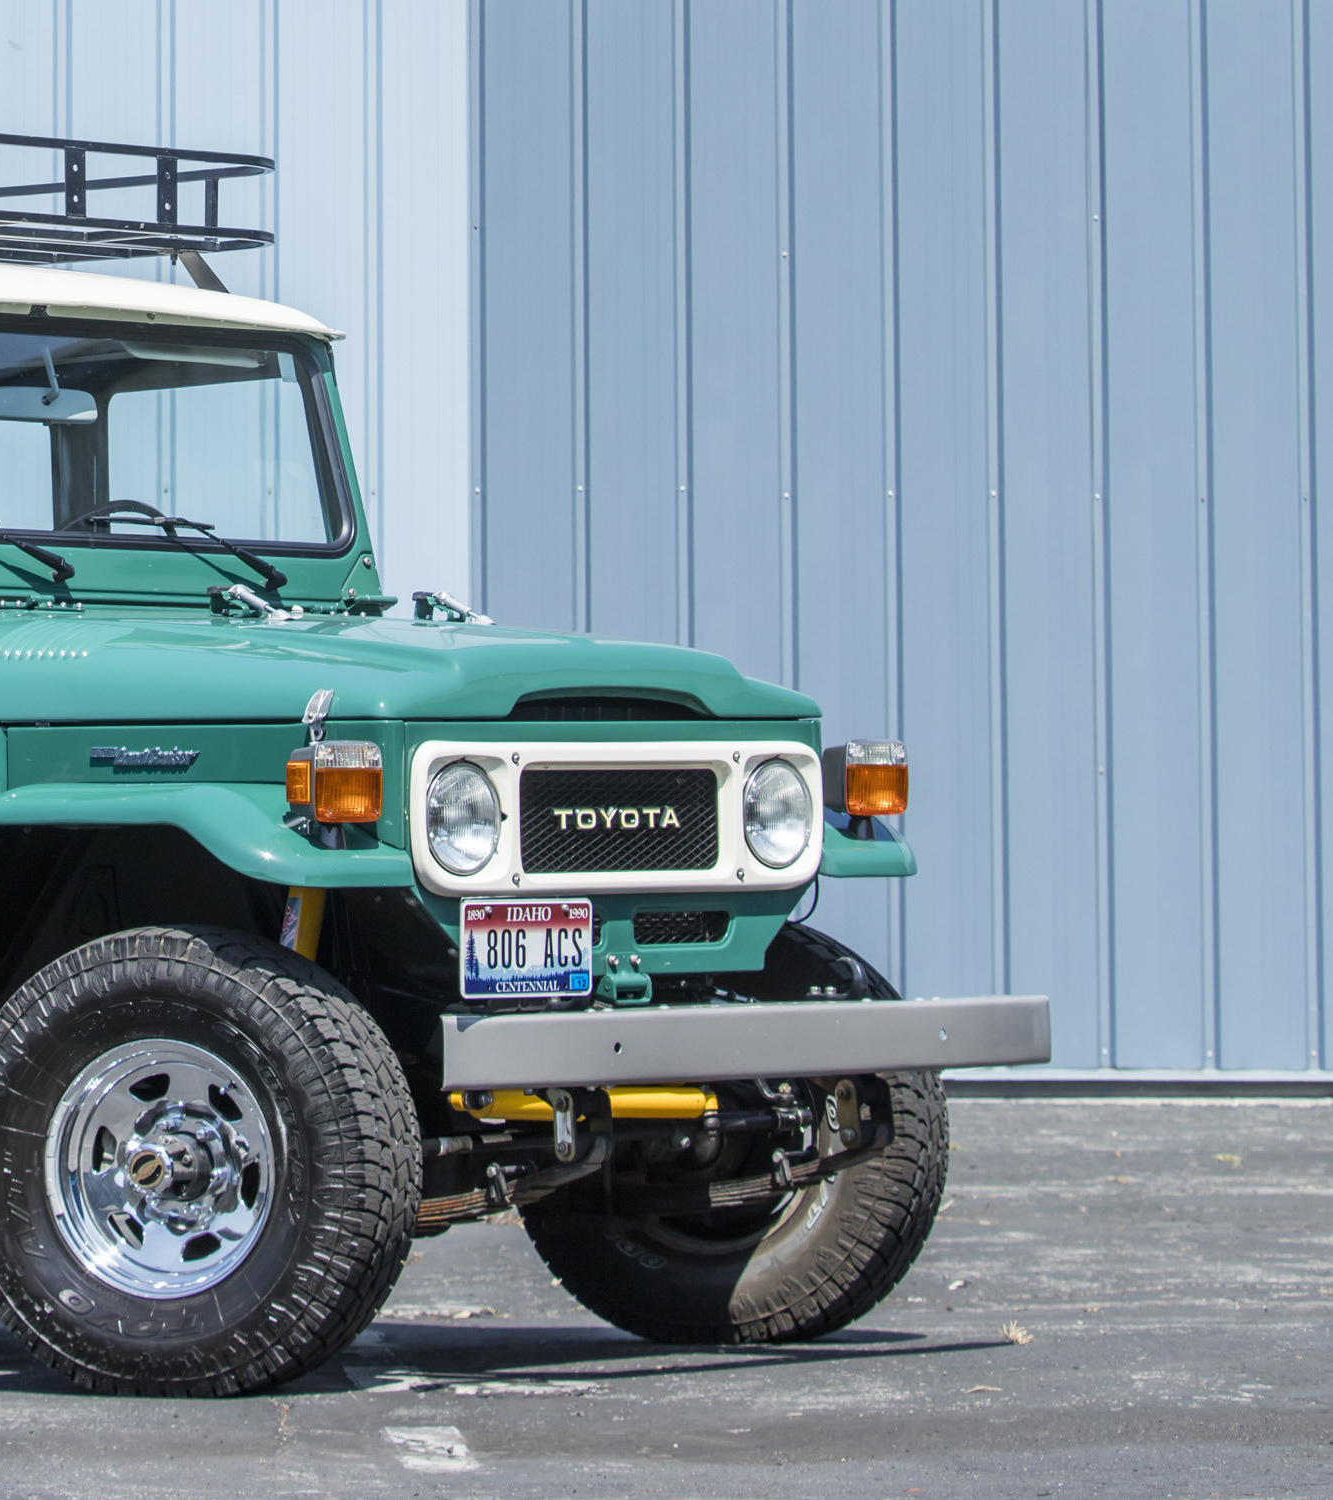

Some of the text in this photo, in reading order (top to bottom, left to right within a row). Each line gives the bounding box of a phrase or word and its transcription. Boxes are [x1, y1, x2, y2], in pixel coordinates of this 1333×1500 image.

[552, 806, 681, 829] TOYOTA
[466, 906, 589, 922] 1890 IDAHO 1990
[487, 927, 583, 969] 806 ACS
[495, 980, 560, 993] CENTENNIAL
[58, 1287, 204, 1340] TOYO
